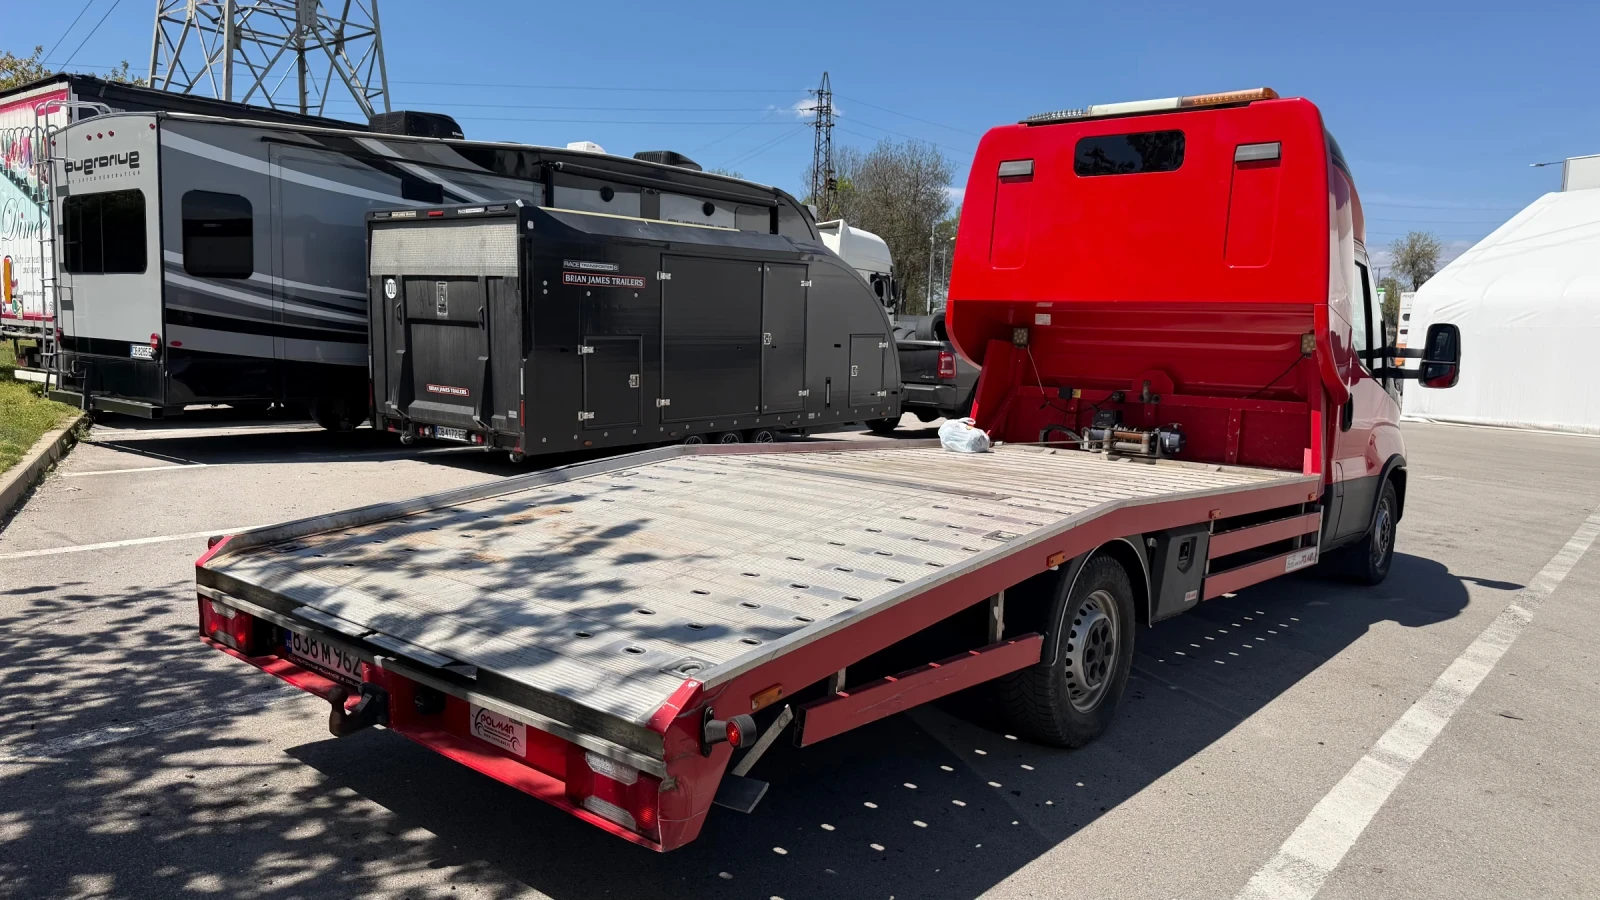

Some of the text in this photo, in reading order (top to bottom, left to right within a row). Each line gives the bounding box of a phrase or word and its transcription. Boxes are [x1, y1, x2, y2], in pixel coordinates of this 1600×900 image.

[565, 274, 644, 287] BRIAN JAMES TRAILERS
[320, 643, 331, 665] M
[481, 714, 515, 735] POLMAR
